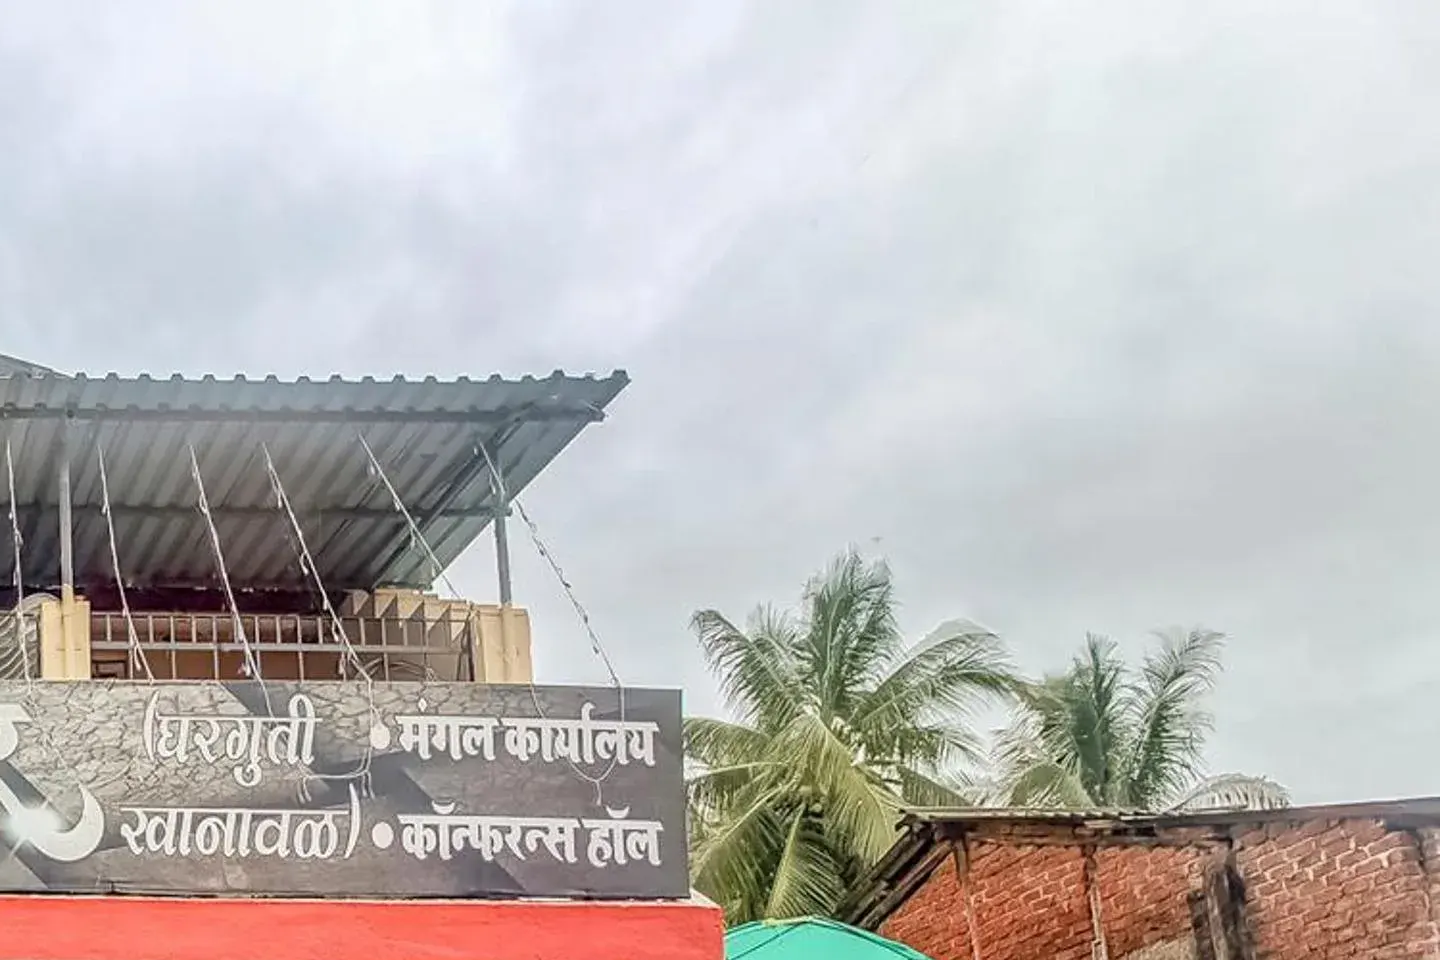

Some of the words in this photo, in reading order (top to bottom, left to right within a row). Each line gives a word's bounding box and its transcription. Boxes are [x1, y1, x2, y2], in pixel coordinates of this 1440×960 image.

[144, 692, 323, 787] (घरगुती
[396, 698, 500, 761] मंगल
[501, 702, 659, 766] कार्यालय
[120, 783, 360, 860] खानावळ)
[398, 801, 578, 864] कॉन्फरन्स
[580, 806, 664, 866] हॉल
